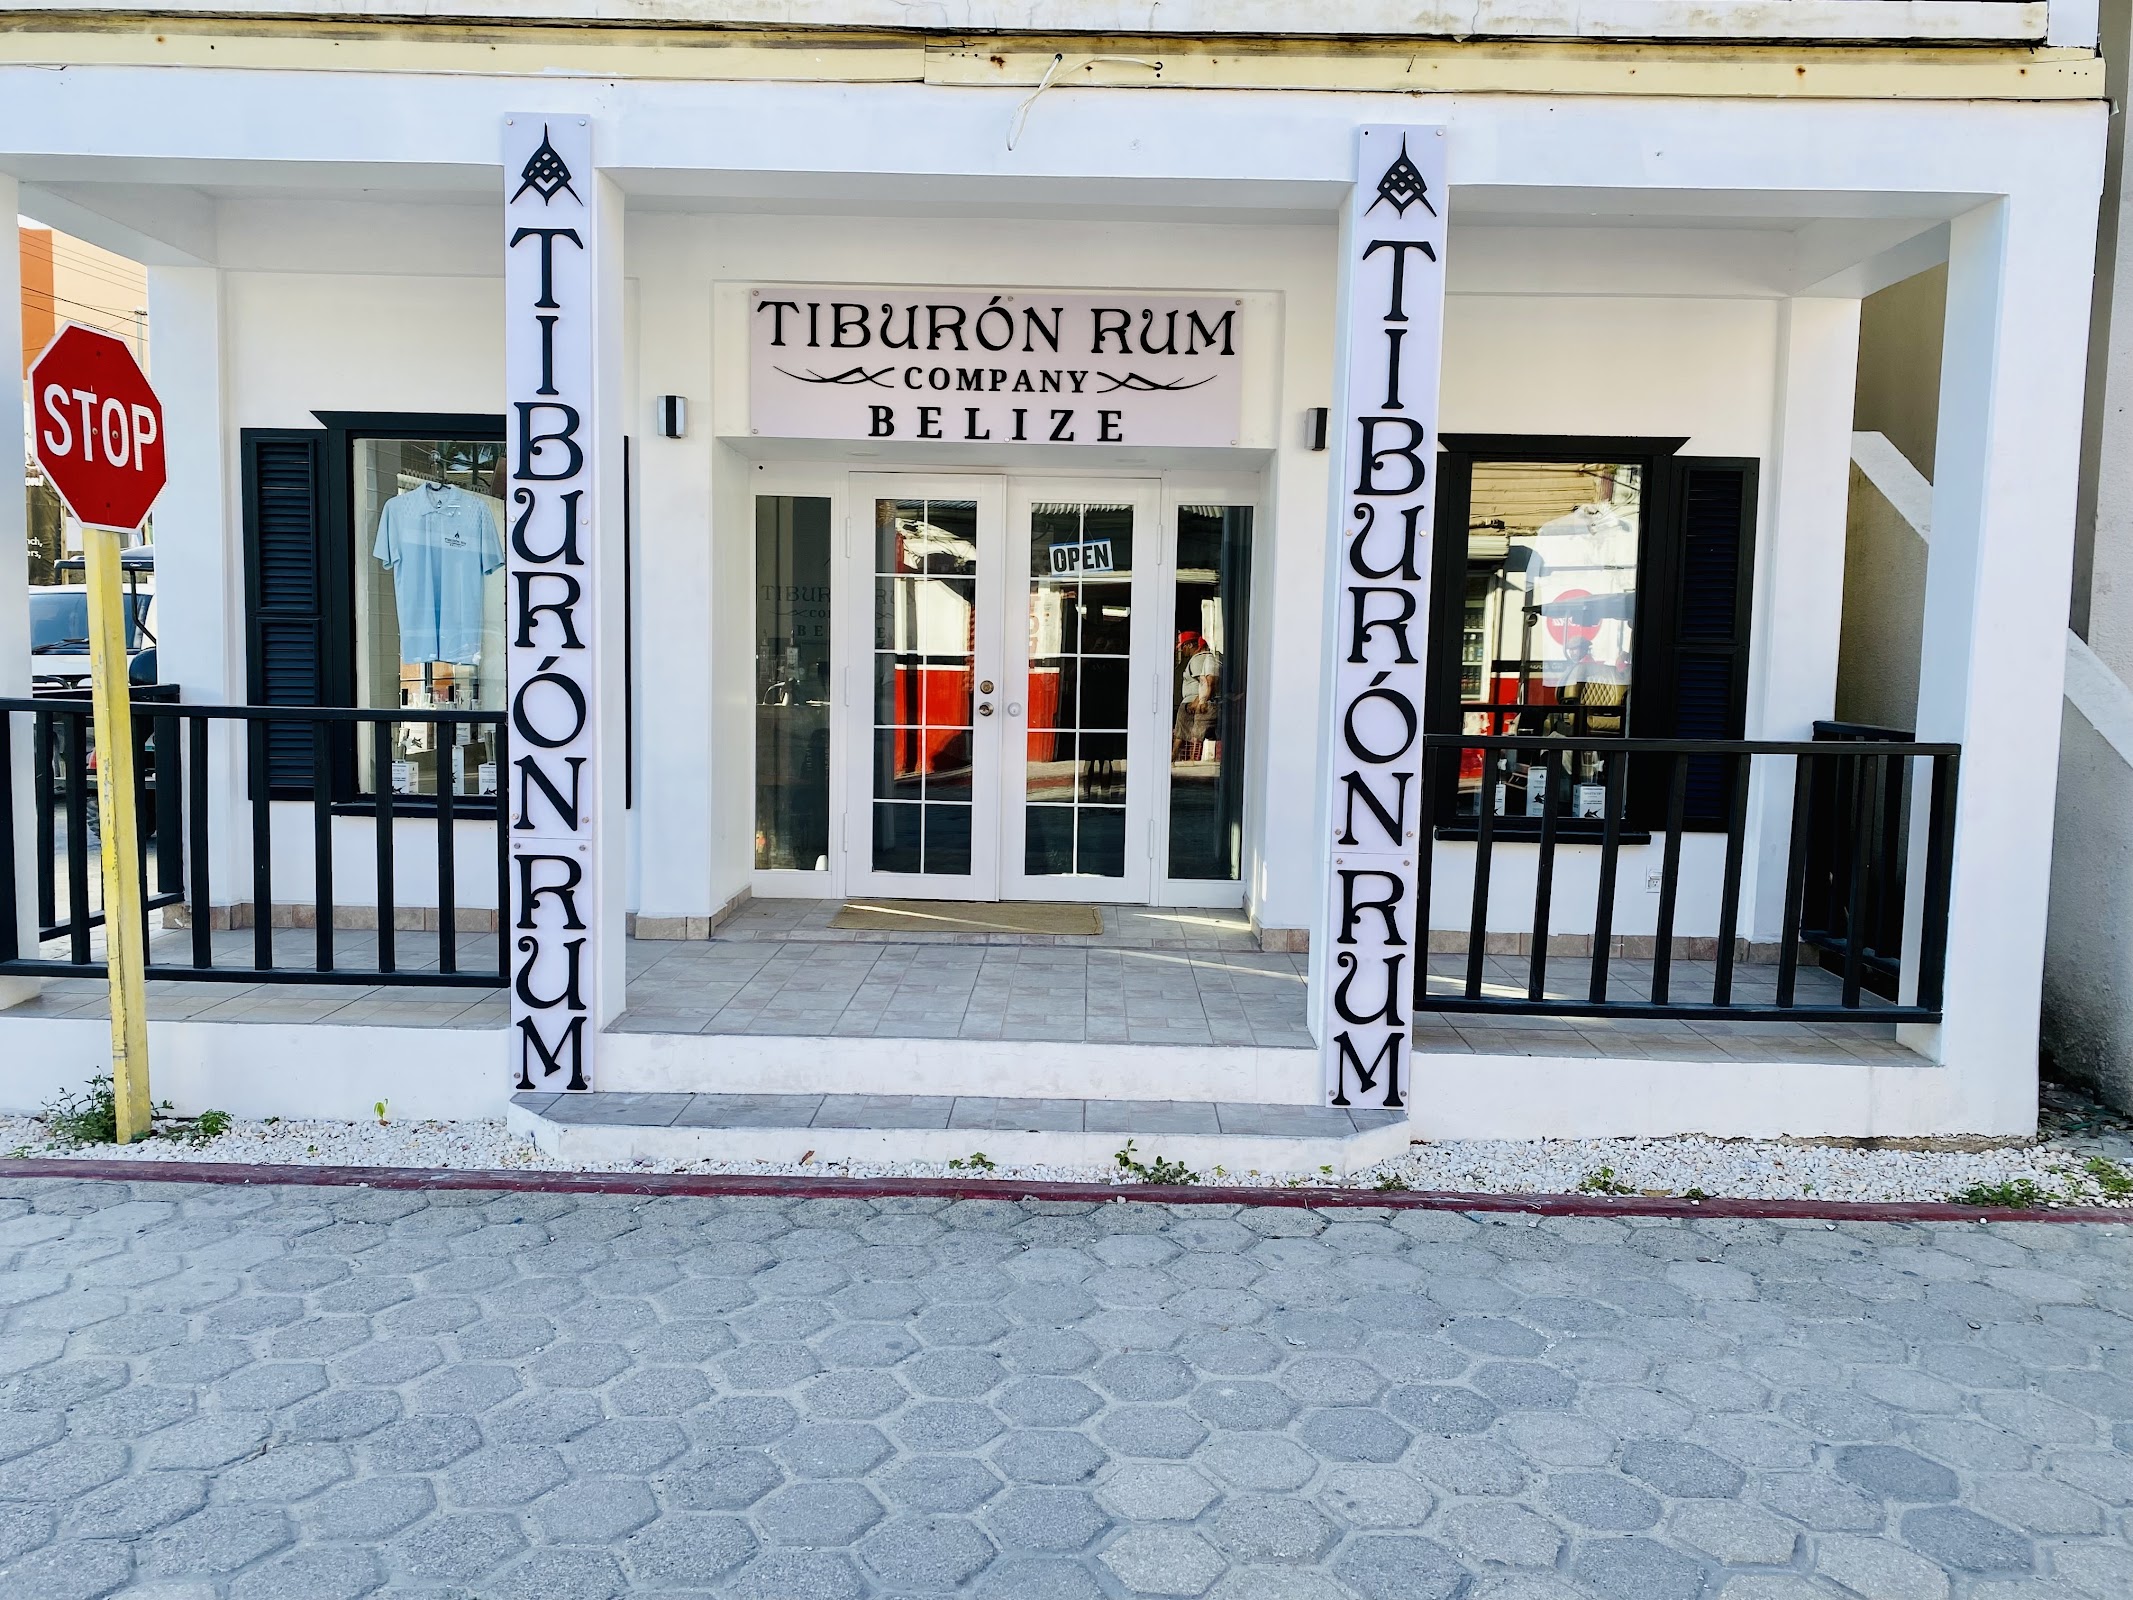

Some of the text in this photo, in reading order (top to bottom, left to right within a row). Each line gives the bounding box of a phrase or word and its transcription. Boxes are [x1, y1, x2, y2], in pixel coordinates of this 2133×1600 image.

[757, 296, 1236, 355] TIBURÓN RUM
[904, 366, 1089, 393] COMPANY
[43, 383, 157, 472] STOP
[868, 405, 1123, 442] BELIZE
[1053, 544, 1110, 573] OPEN
[509, 227, 588, 1091] TIBURÓN RUM
[1331, 239, 1437, 1107] TIBURÓN RUM
